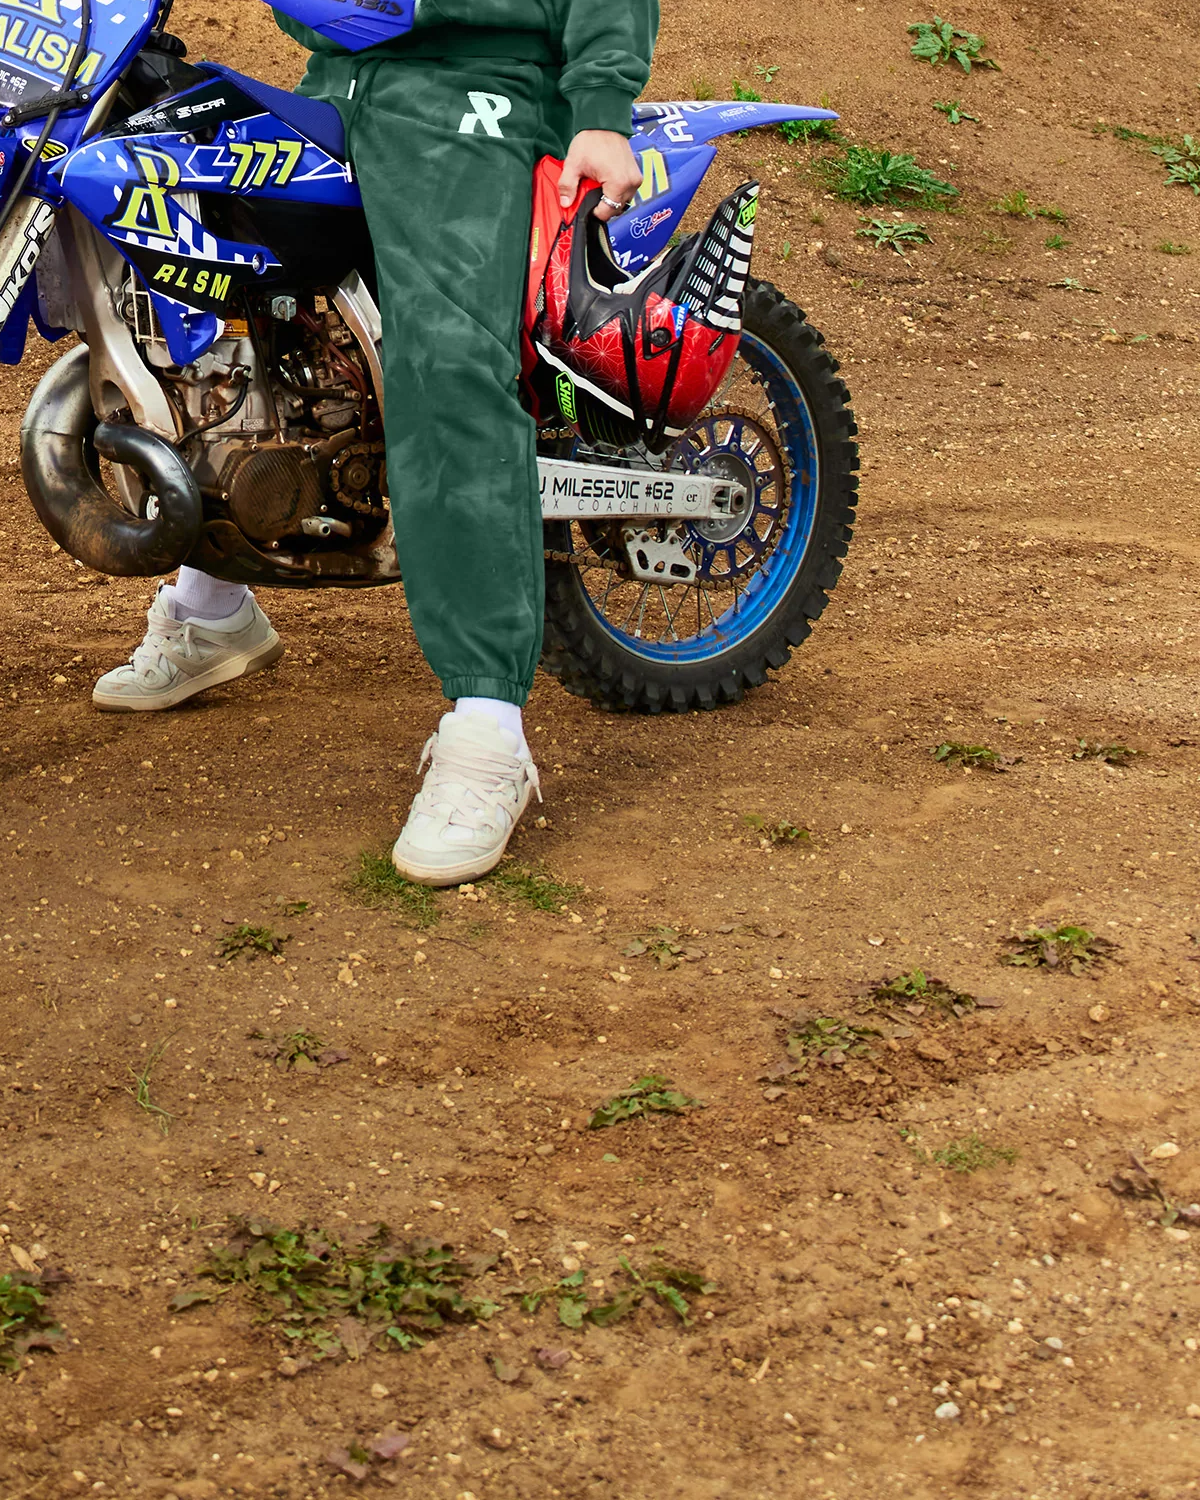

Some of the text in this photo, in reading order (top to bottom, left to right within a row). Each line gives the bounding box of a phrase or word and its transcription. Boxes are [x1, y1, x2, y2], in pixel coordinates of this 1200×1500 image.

[228, 139, 303, 188] 777
[153, 263, 232, 302] RLSM
[559, 378, 575, 419] SHOEI
[552, 476, 640, 500] MILESEVIC
[644, 481, 675, 501] #62
[577, 499, 673, 514] COACHING
